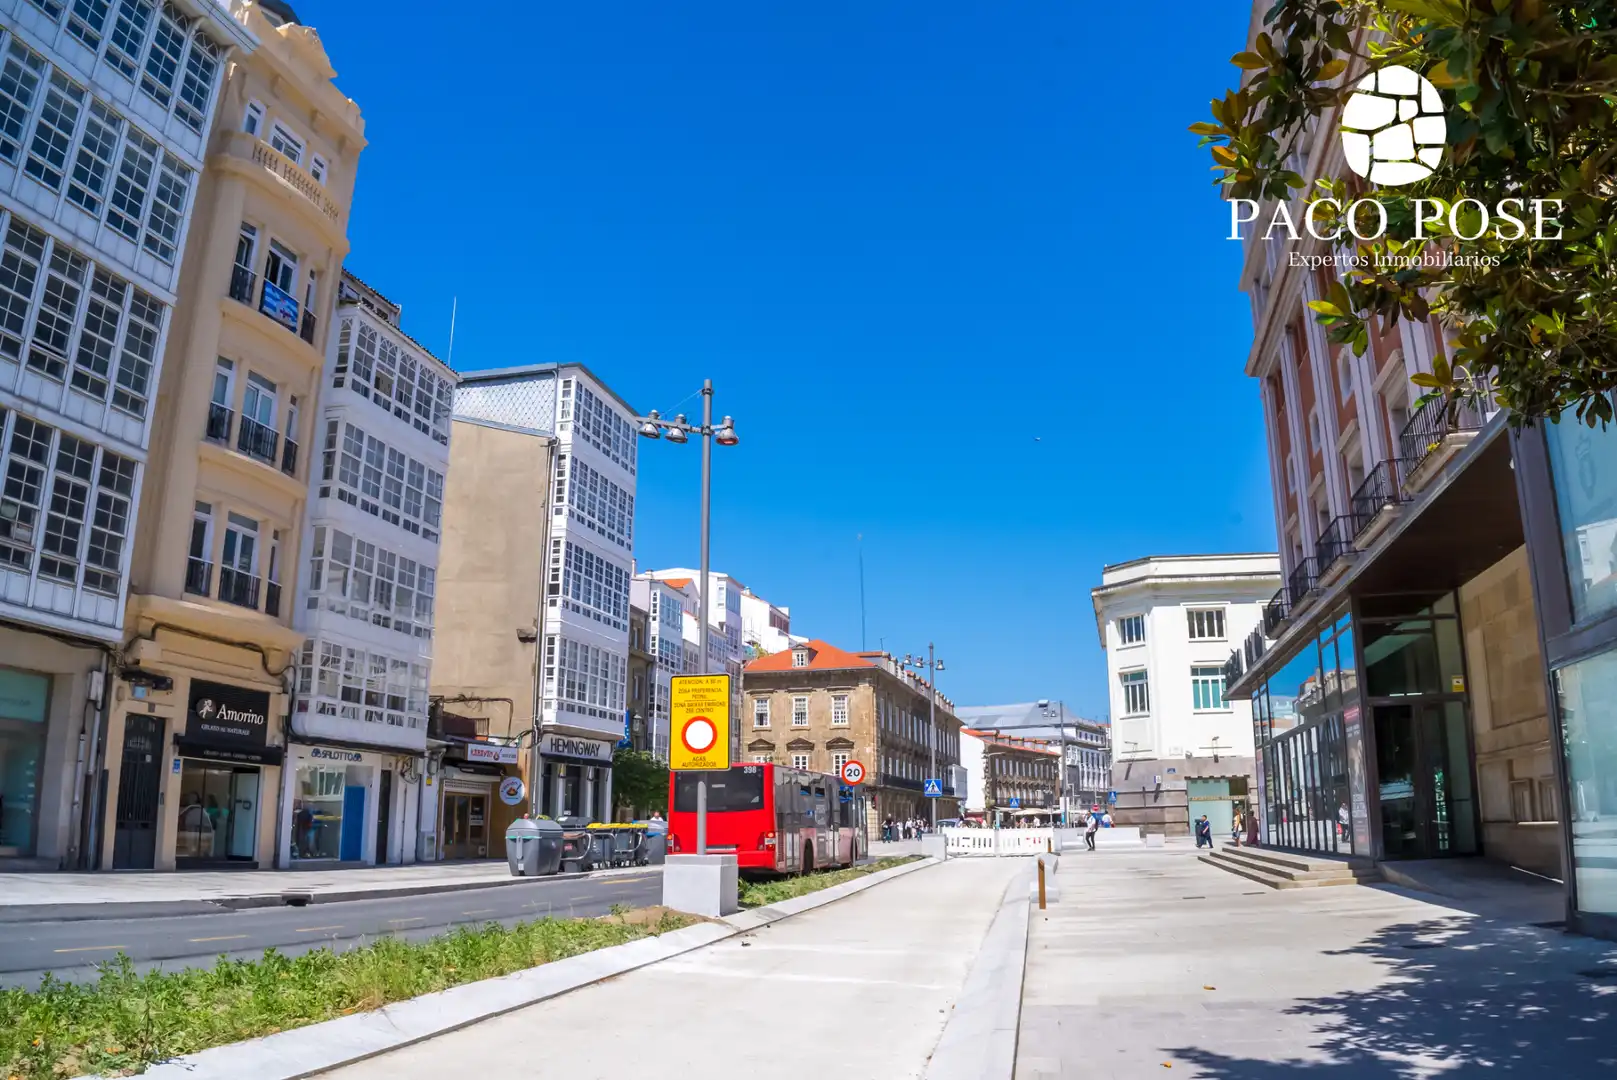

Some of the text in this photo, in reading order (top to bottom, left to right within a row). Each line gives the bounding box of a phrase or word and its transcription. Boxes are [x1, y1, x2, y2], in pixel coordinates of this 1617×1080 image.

[216, 703, 264, 725] Amorino
[550, 736, 601, 757] HEMINGWAY
[846, 768, 861, 777] 20
